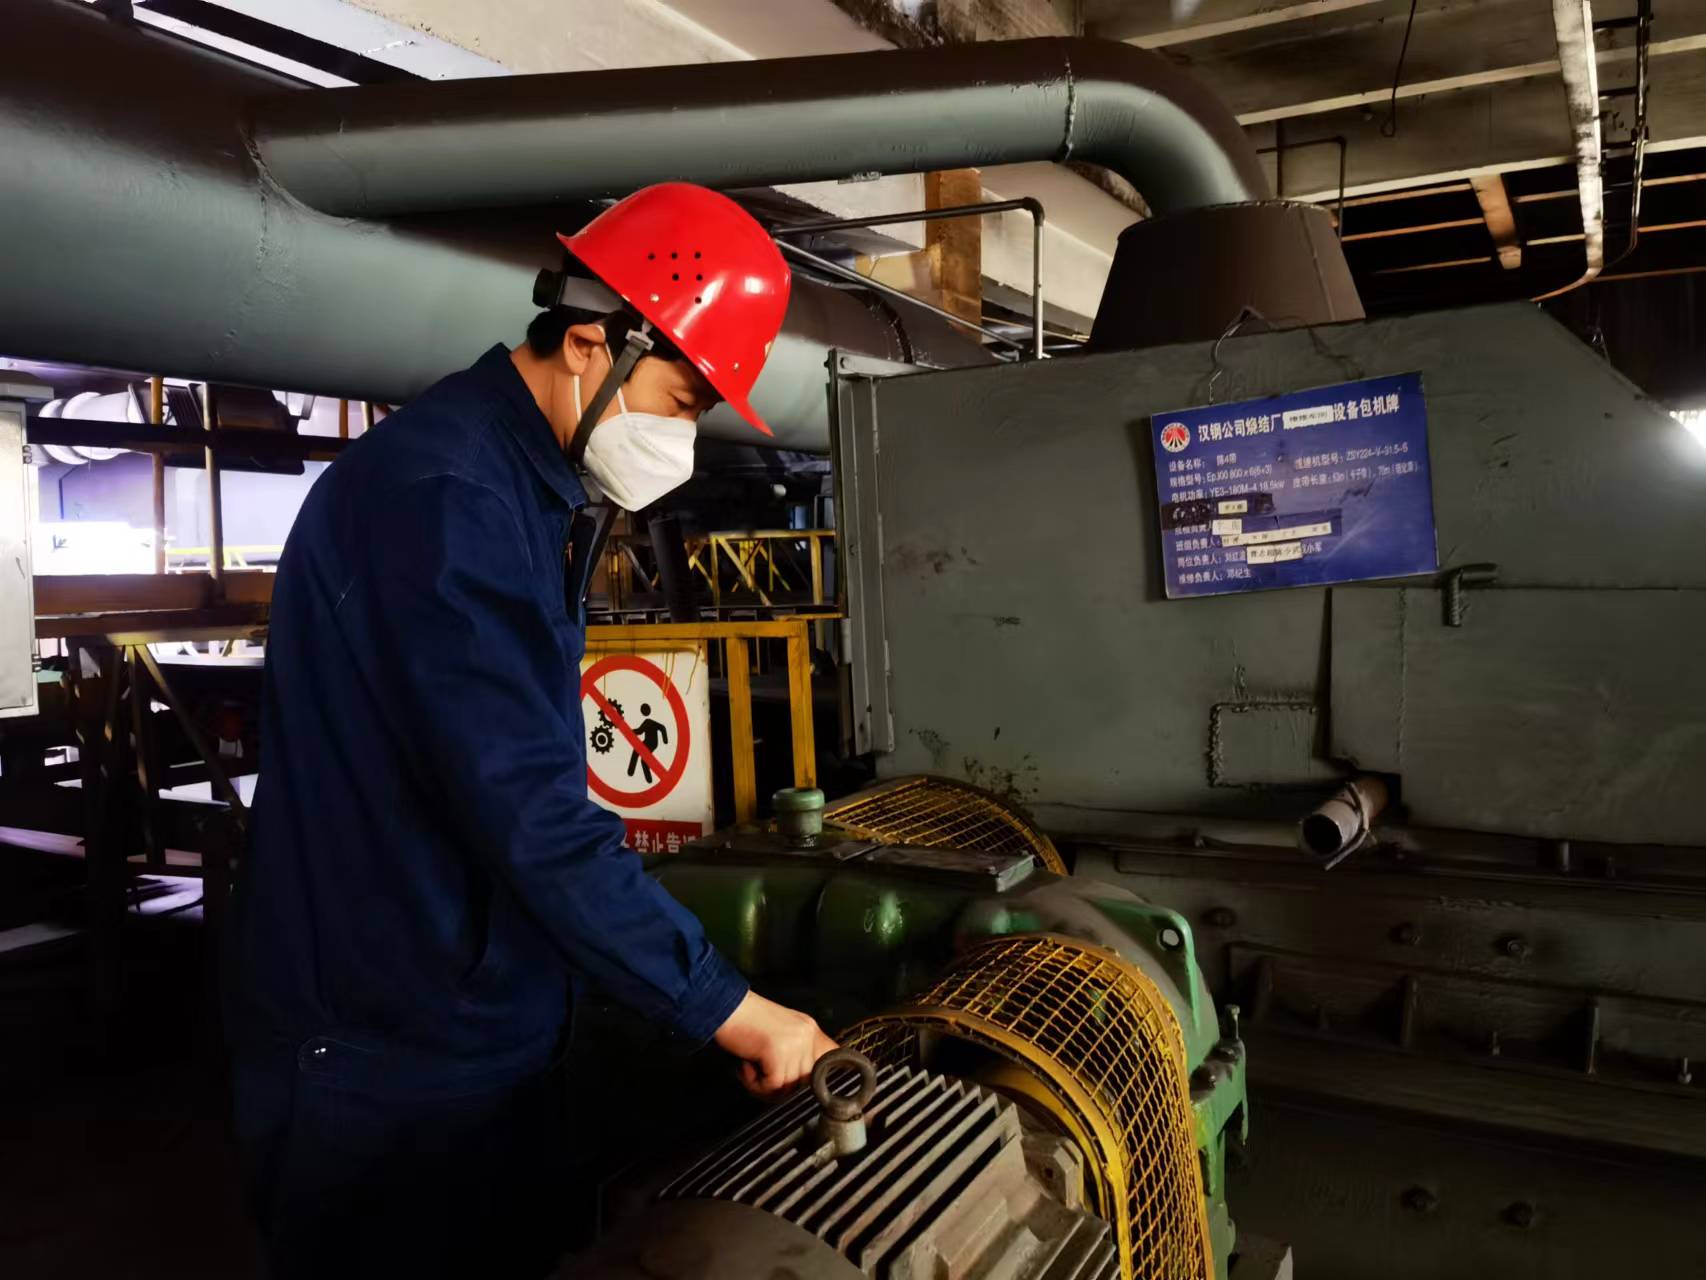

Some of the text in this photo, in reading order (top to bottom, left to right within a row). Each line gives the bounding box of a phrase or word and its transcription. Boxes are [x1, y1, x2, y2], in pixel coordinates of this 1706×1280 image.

[1198, 413, 1281, 442] 汉钢公司烧结厂
[1333, 393, 1399, 422] 设备包机牌
